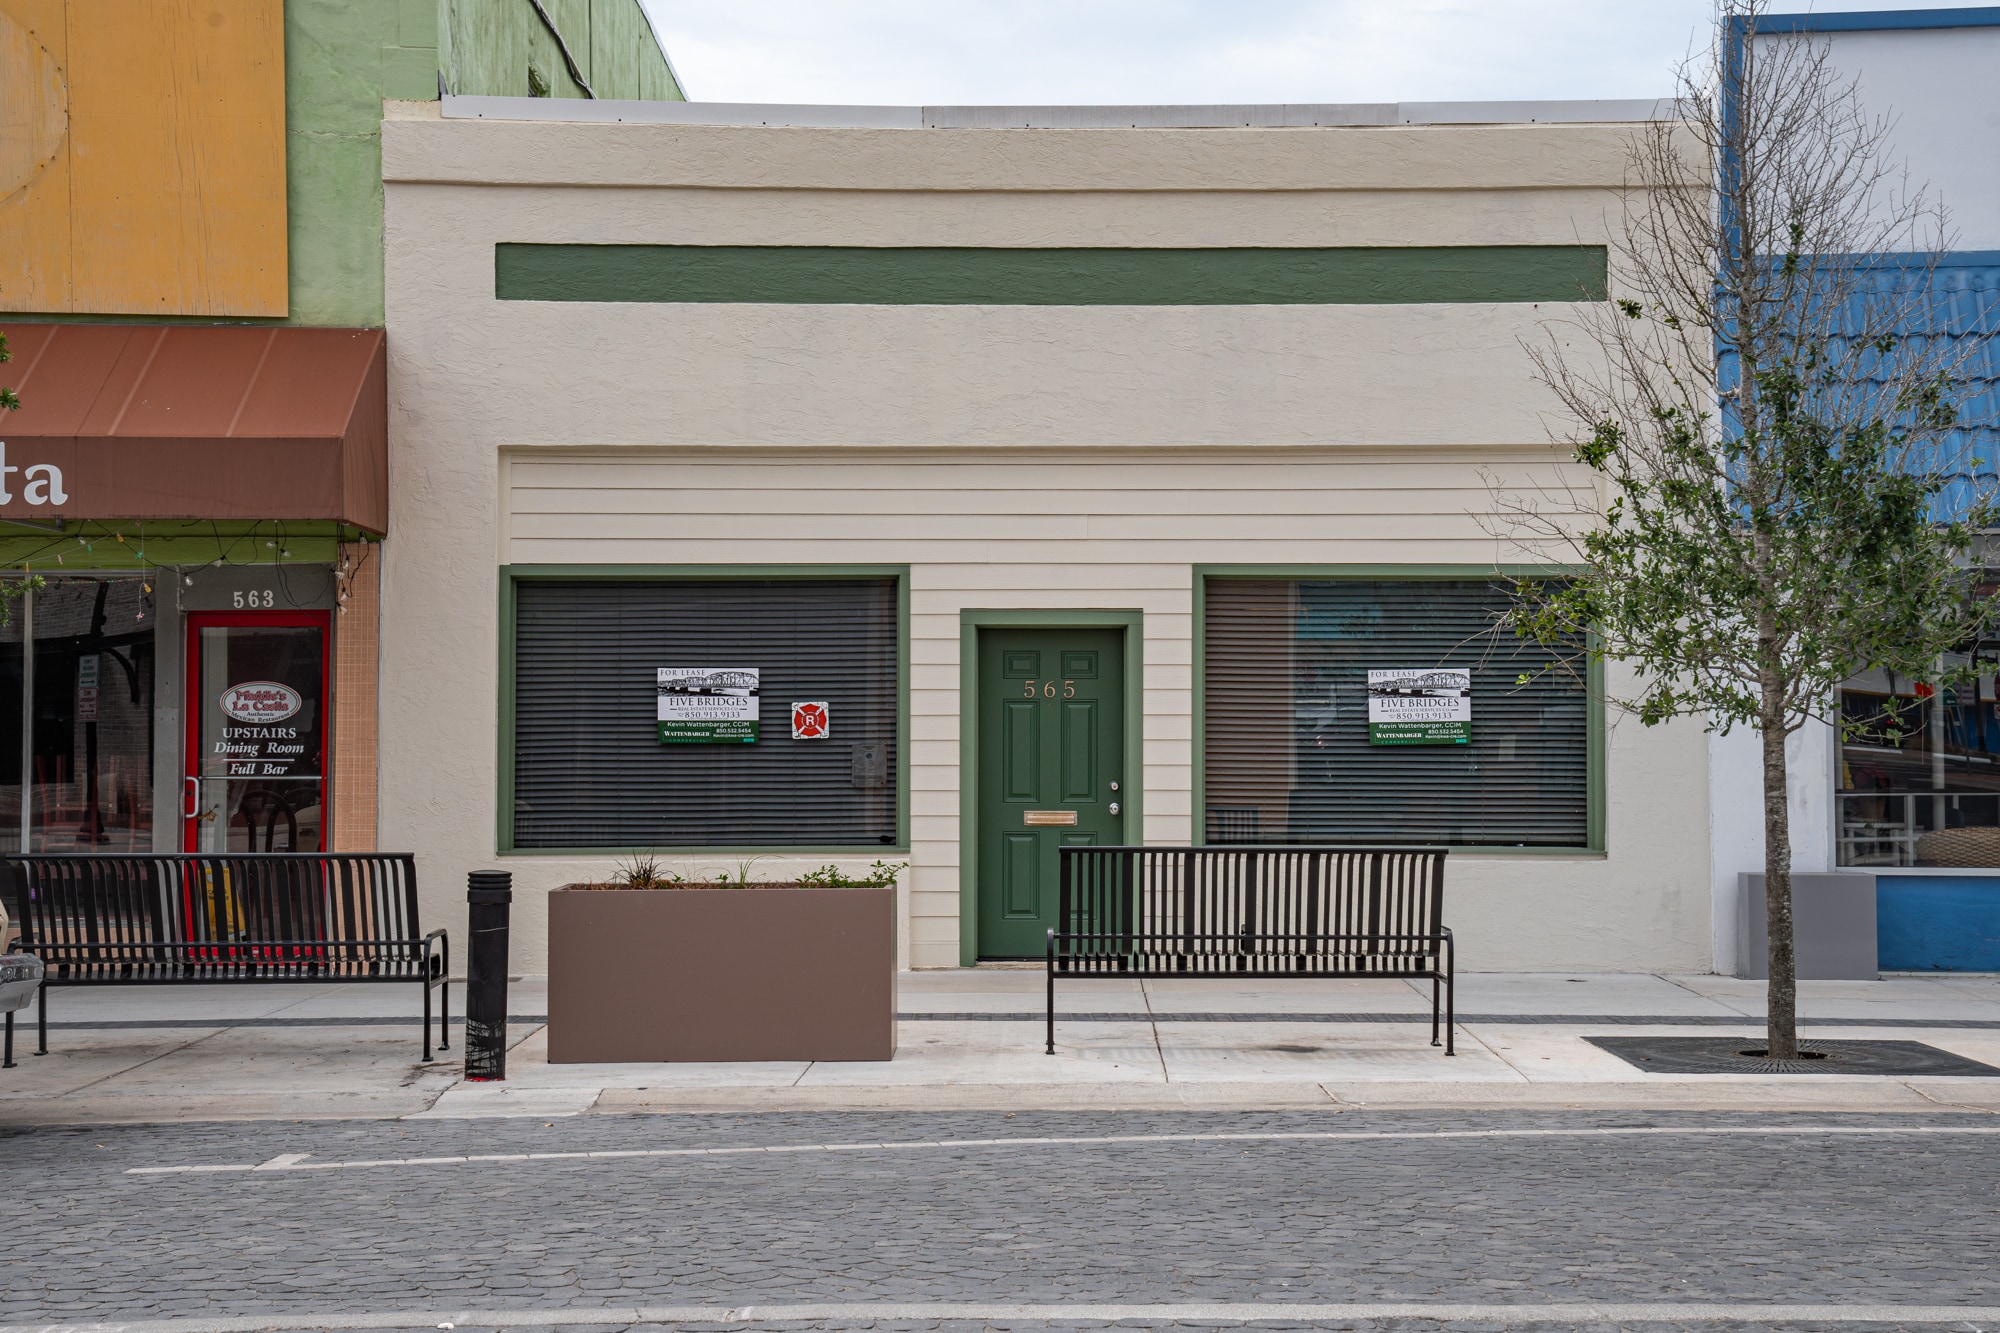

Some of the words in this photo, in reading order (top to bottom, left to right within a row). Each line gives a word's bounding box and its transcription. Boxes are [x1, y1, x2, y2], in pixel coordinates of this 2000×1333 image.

[233, 590, 274, 608] 563
[1023, 680, 1075, 698] 565
[232, 701, 249, 711] La
[670, 697, 694, 706] FIVE
[697, 697, 748, 706] BRIDGES
[1381, 698, 1405, 708] FIVE
[1409, 697, 1459, 707] BRIDGES
[231, 711, 255, 722] Mexican
[258, 712, 290, 722] Restaurant
[806, 715, 814, 726] R
[222, 727, 296, 738] UPSTAIRS
[214, 742, 260, 757] Dining
[266, 742, 304, 753] Room
[230, 763, 256, 774] Full
[262, 763, 288, 774] Bar
